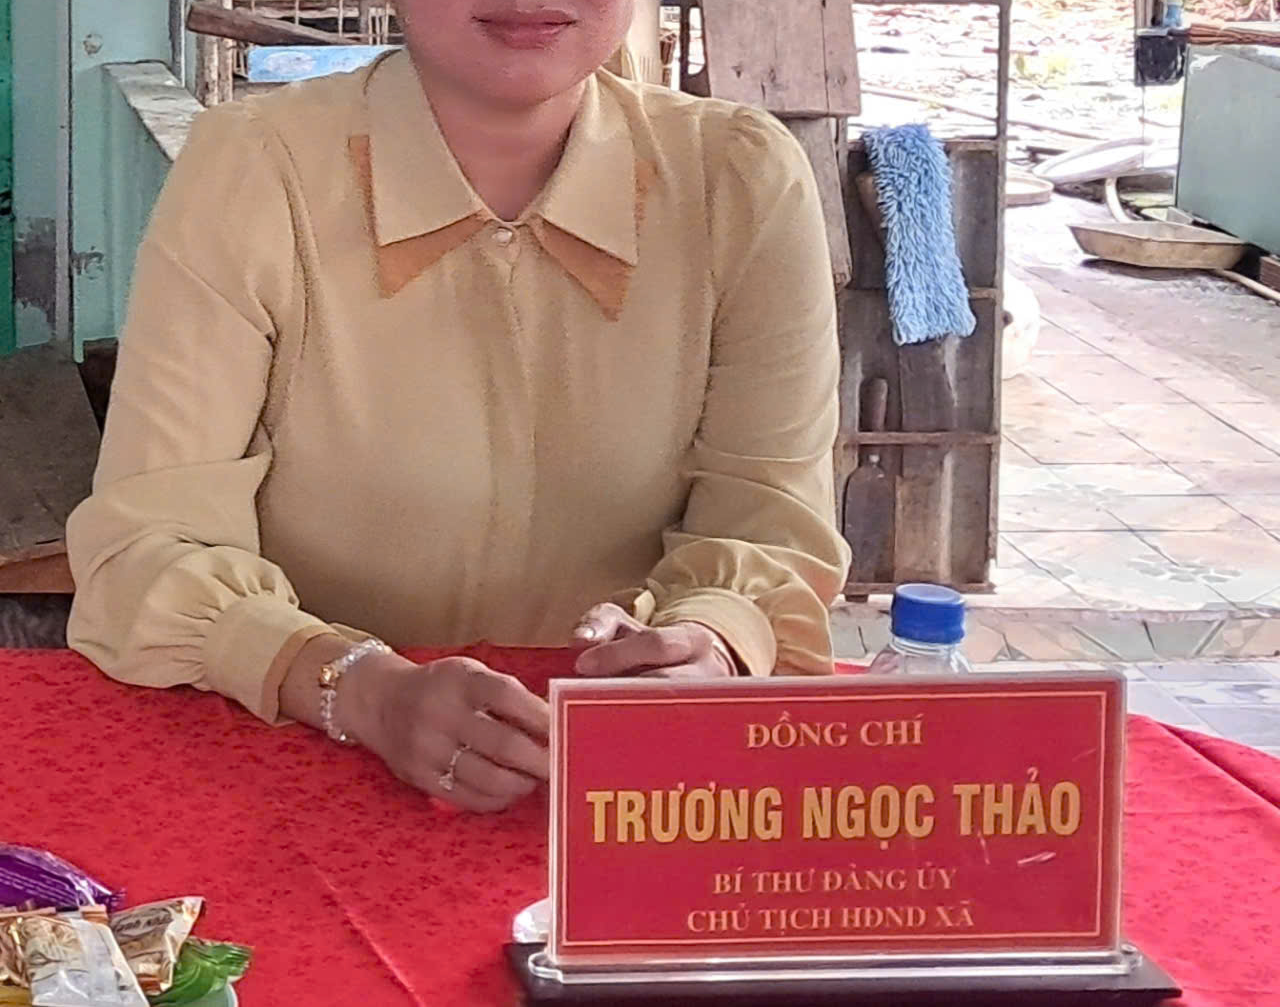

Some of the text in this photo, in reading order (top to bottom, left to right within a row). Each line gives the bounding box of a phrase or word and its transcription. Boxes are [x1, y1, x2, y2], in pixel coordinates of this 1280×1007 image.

[747, 710, 924, 748] ĐỒNG CHÍ
[585, 766, 1081, 850] TRƯƠNG NGỌC THẢO
[713, 862, 957, 894] BÍ THƯ ĐẢNG ỦY
[686, 900, 974, 936] CHỦ TỊCH HĐND XÃ
